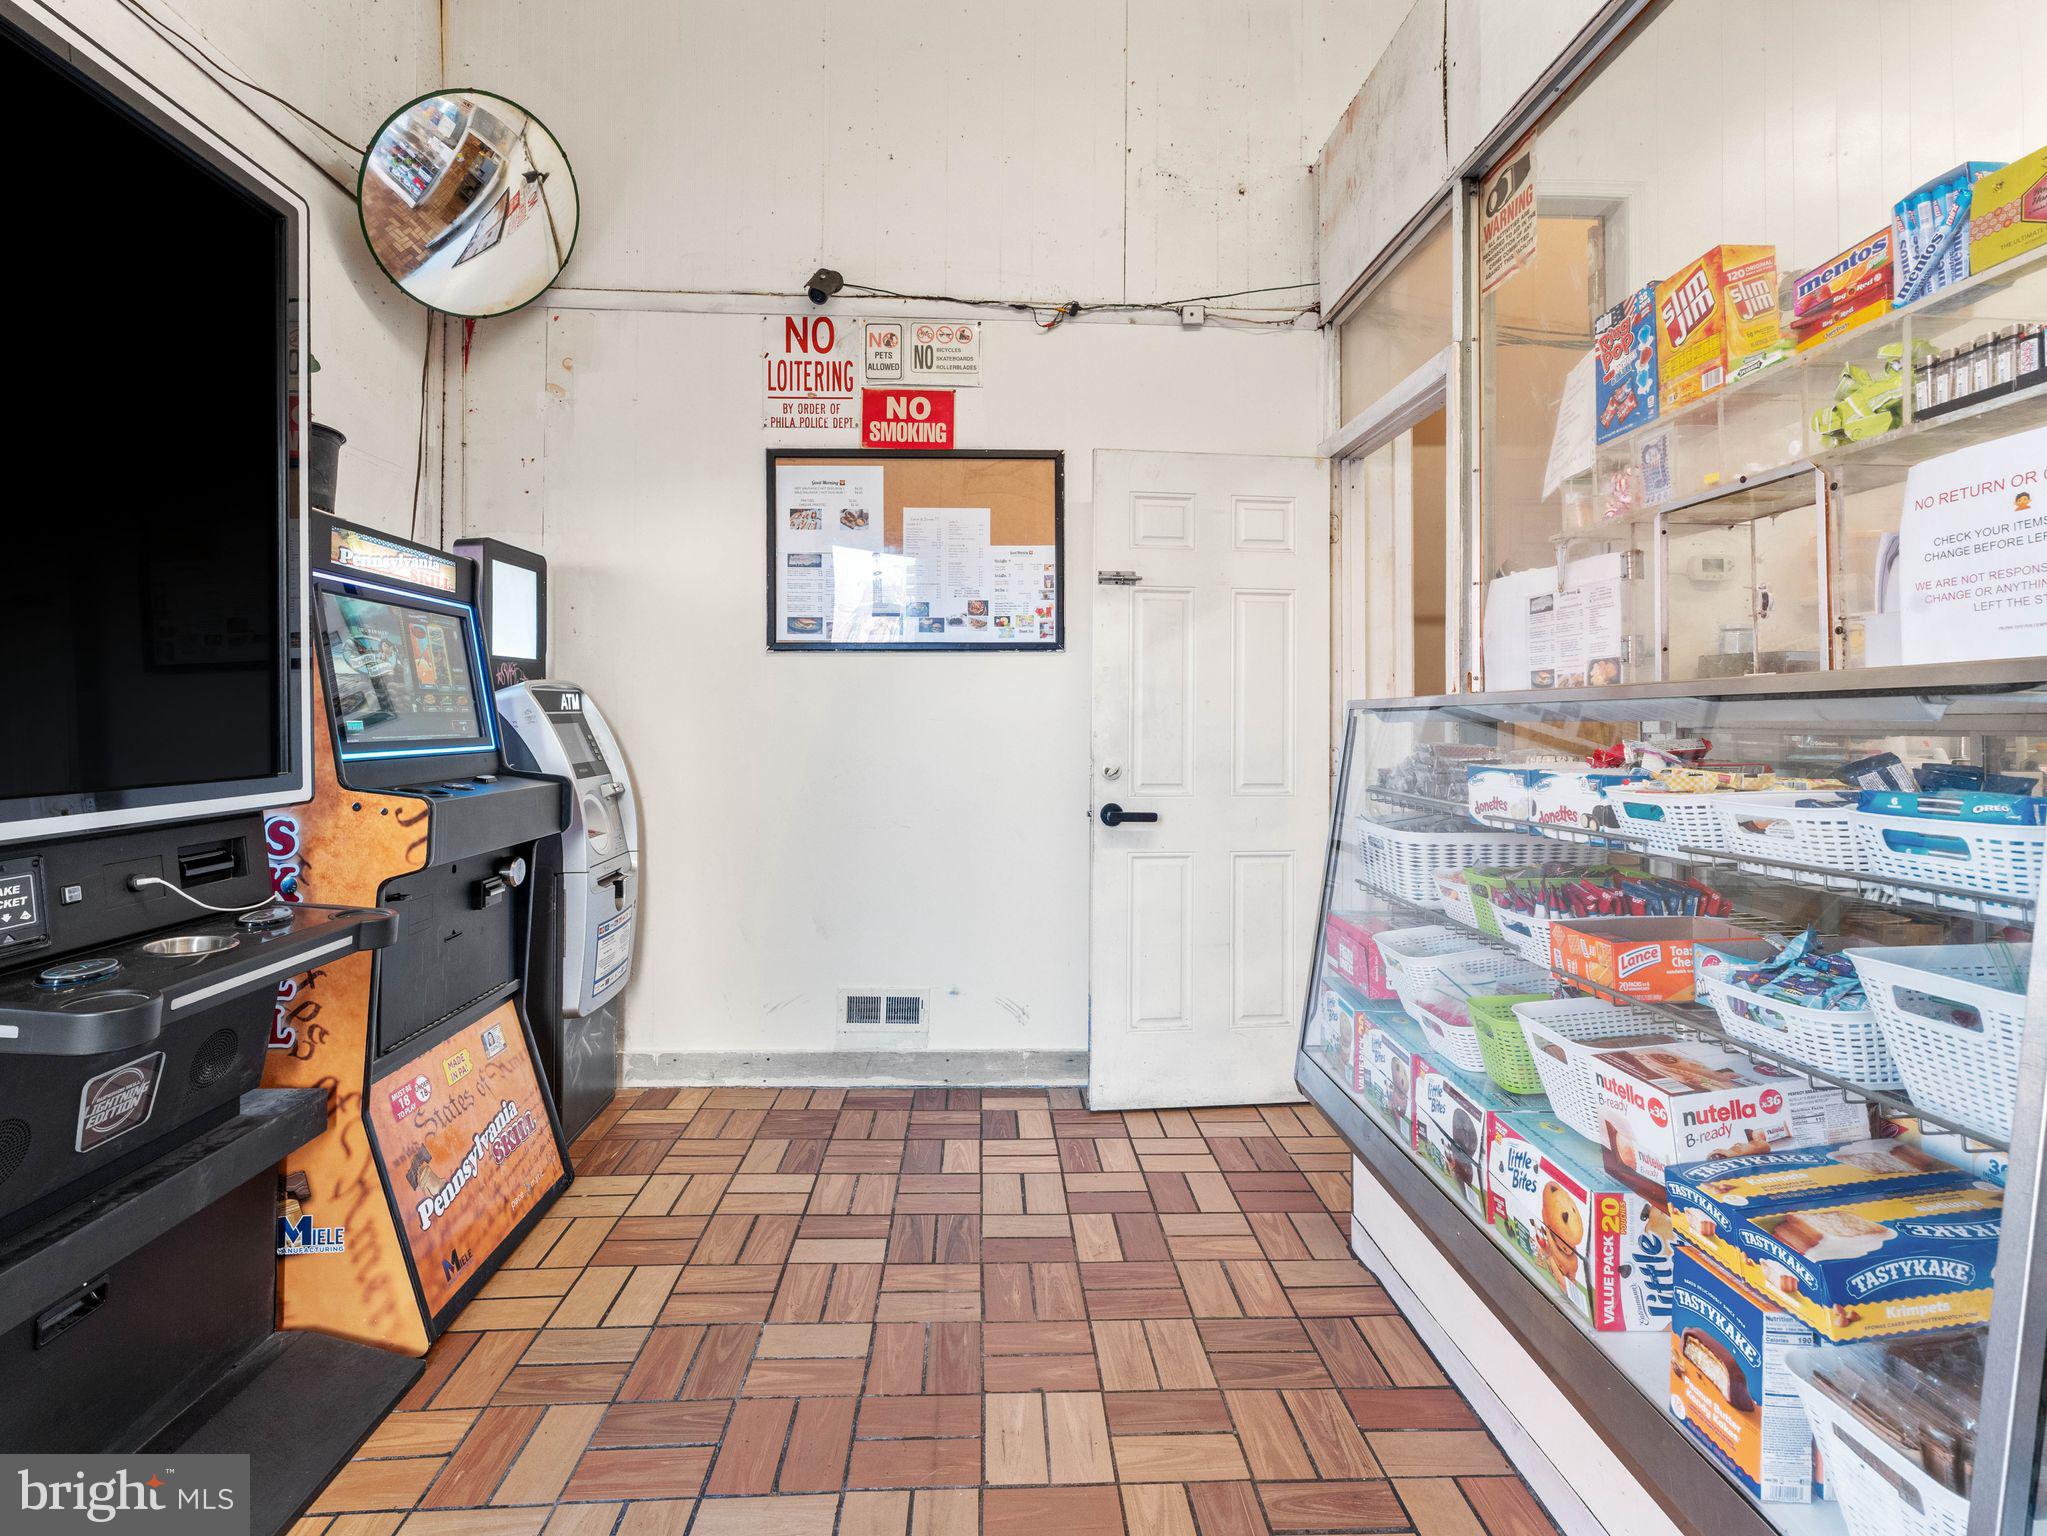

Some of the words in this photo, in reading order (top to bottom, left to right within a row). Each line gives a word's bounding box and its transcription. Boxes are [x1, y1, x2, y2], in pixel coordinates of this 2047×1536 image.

[1484, 184, 1533, 243] WARNING
[2013, 225, 2044, 245] ULTIMATE
[1726, 269, 1746, 282] 120
[1797, 235, 1888, 299] mentos
[1897, 232, 1944, 300] mentos
[1833, 292, 1847, 303] Big
[1856, 279, 1873, 291] Red
[785, 316, 835, 354] NO
[867, 362, 900, 371] ALLOWED
[874, 351, 893, 360] PETS
[914, 344, 934, 370] NO
[767, 360, 854, 393] LOITERING
[783, 403, 794, 415] BY
[797, 403, 826, 415] ORDER
[830, 403, 841, 415] OF
[886, 396, 931, 420] NO
[799, 417, 828, 429] POLICE
[869, 421, 947, 443] SMOKING
[1915, 496, 1935, 511] NO
[1939, 478, 2005, 505] RETURN
[2011, 470, 2037, 488] OR
[1934, 530, 1972, 547] CHECK
[1974, 523, 2010, 539] YOUR
[338, 546, 440, 571] Pennsylvania
[1924, 545, 1971, 562] CHANGE
[1973, 536, 2024, 555] BEFORE
[410, 570, 452, 590] SKILL
[1915, 581, 1932, 592] WE
[1935, 577, 1958, 590] ARE
[1961, 573, 1985, 585] NOT
[1924, 589, 1971, 605] CHANGE
[1974, 586, 1993, 597] OR
[1973, 599, 2002, 612] LEFT
[2005, 596, 2031, 608] THE
[561, 693, 580, 711] ATM
[1475, 796, 1508, 815] donettes
[1891, 797, 1898, 805] 6
[1972, 804, 2010, 814] OREO
[1538, 805, 1579, 824] donettes
[1621, 949, 1659, 970] Lance
[1618, 981, 1629, 992] 20
[447, 1053, 466, 1071] MADE
[450, 1071, 459, 1081] IN
[85, 1080, 151, 1116] LIGHTNING
[390, 1088, 406, 1101] MUST
[405, 1084, 413, 1093] BE
[398, 1096, 412, 1110] 18
[414, 1088, 475, 1130] States
[476, 1069, 491, 1098] of
[1427, 1083, 1443, 1099] Little
[1594, 1071, 1646, 1111] nutella
[1760, 1094, 1782, 1110] x36
[86, 1095, 140, 1130] EDITION
[396, 1111, 405, 1119] TO
[404, 1103, 417, 1116] PLAY
[1431, 1100, 1446, 1115] Bites
[1598, 1092, 1629, 1117] B-ready
[1683, 1099, 1757, 1128] nutella
[492, 1109, 538, 1165] SKILL
[1685, 1123, 1734, 1148] B-ready
[416, 1099, 519, 1232] Pennsylvania
[1508, 1148, 1532, 1171] Little
[1688, 1154, 1820, 1179] TASTYKAKE
[1512, 1171, 1537, 1193] Bites
[1601, 1197, 1620, 1234] 20
[1668, 1183, 1730, 1228] TASTYKAKE
[1619, 1200, 1627, 1236] POUCHES
[1603, 1235, 1615, 1277] PACK
[1741, 1231, 1815, 1287] TASTYKAKE
[1851, 1258, 1970, 1293] TASTYKAKE
[1603, 1277, 1615, 1325] VALUE
[1886, 1301, 1951, 1319] Krimpets
[1676, 1288, 1757, 1363] TASTYKAKE
[1864, 1323, 1887, 1331] SPONGE
[1920, 1314, 1963, 1324] BUTTERSCOTCH
[1683, 1375, 1713, 1405] Peanut
[1712, 1402, 1742, 1433] Butter
[1685, 1388, 1712, 1420] Kandy
